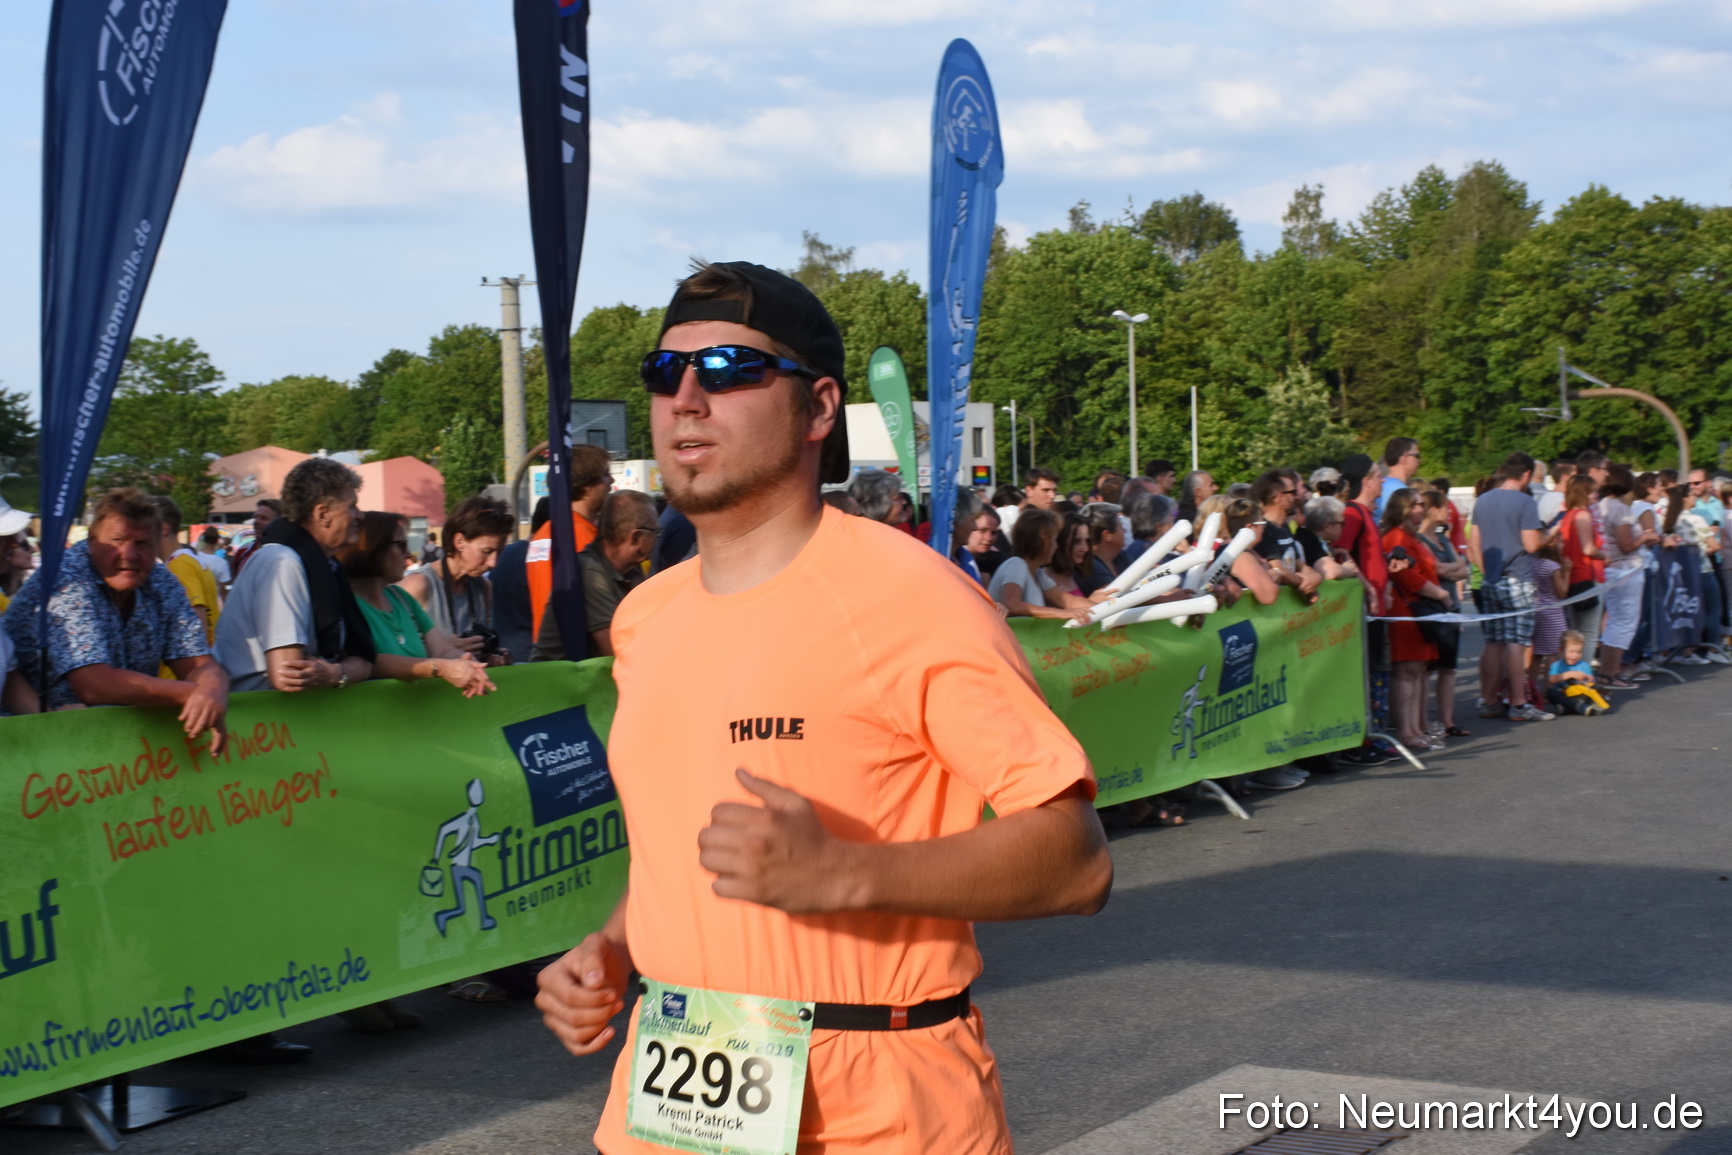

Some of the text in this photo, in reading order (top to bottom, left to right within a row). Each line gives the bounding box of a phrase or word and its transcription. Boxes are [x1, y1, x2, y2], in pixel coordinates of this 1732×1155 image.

[115, 0, 166, 96] Fisc
[141, 0, 180, 95] AUTOMO
[729, 717, 804, 744] THULE
[1201, 664, 1287, 734] firmenlauf
[21, 736, 179, 819] Gesunde
[533, 741, 589, 768] Fischer
[102, 752, 338, 861] laufen länger!
[505, 866, 593, 918] neumarkt
[642, 1040, 773, 1115] 2298
[670, 1122, 692, 1136] Thule
[695, 1111, 745, 1132] Patrick
